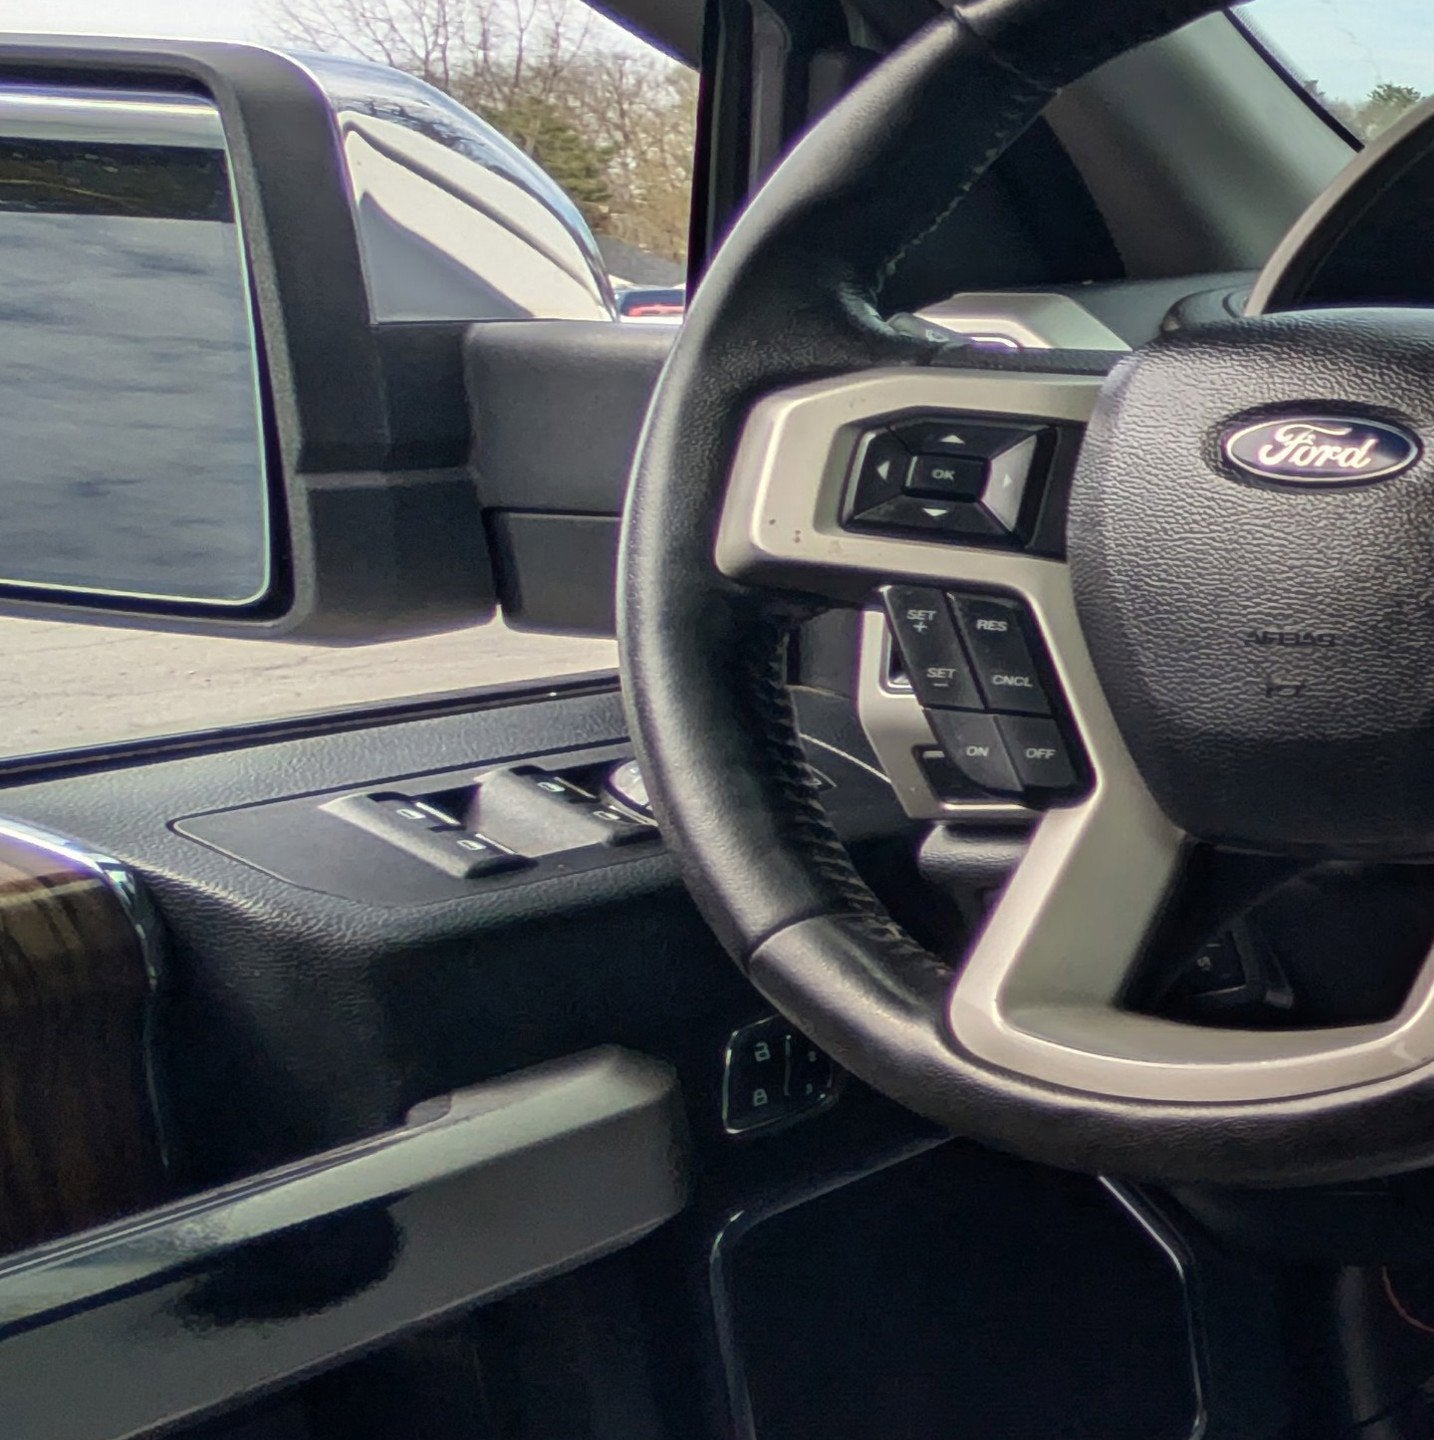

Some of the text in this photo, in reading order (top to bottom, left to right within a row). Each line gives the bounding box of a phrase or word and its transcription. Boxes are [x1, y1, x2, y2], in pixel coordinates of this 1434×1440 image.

[1258, 423, 1378, 469] Ford
[932, 468, 954, 480] OK
[907, 610, 937, 621] SET
[976, 619, 1008, 631] RES
[926, 668, 956, 679] SET
[992, 674, 1034, 687] CNCL
[966, 746, 989, 757] ON
[1026, 748, 1056, 759] OFF
